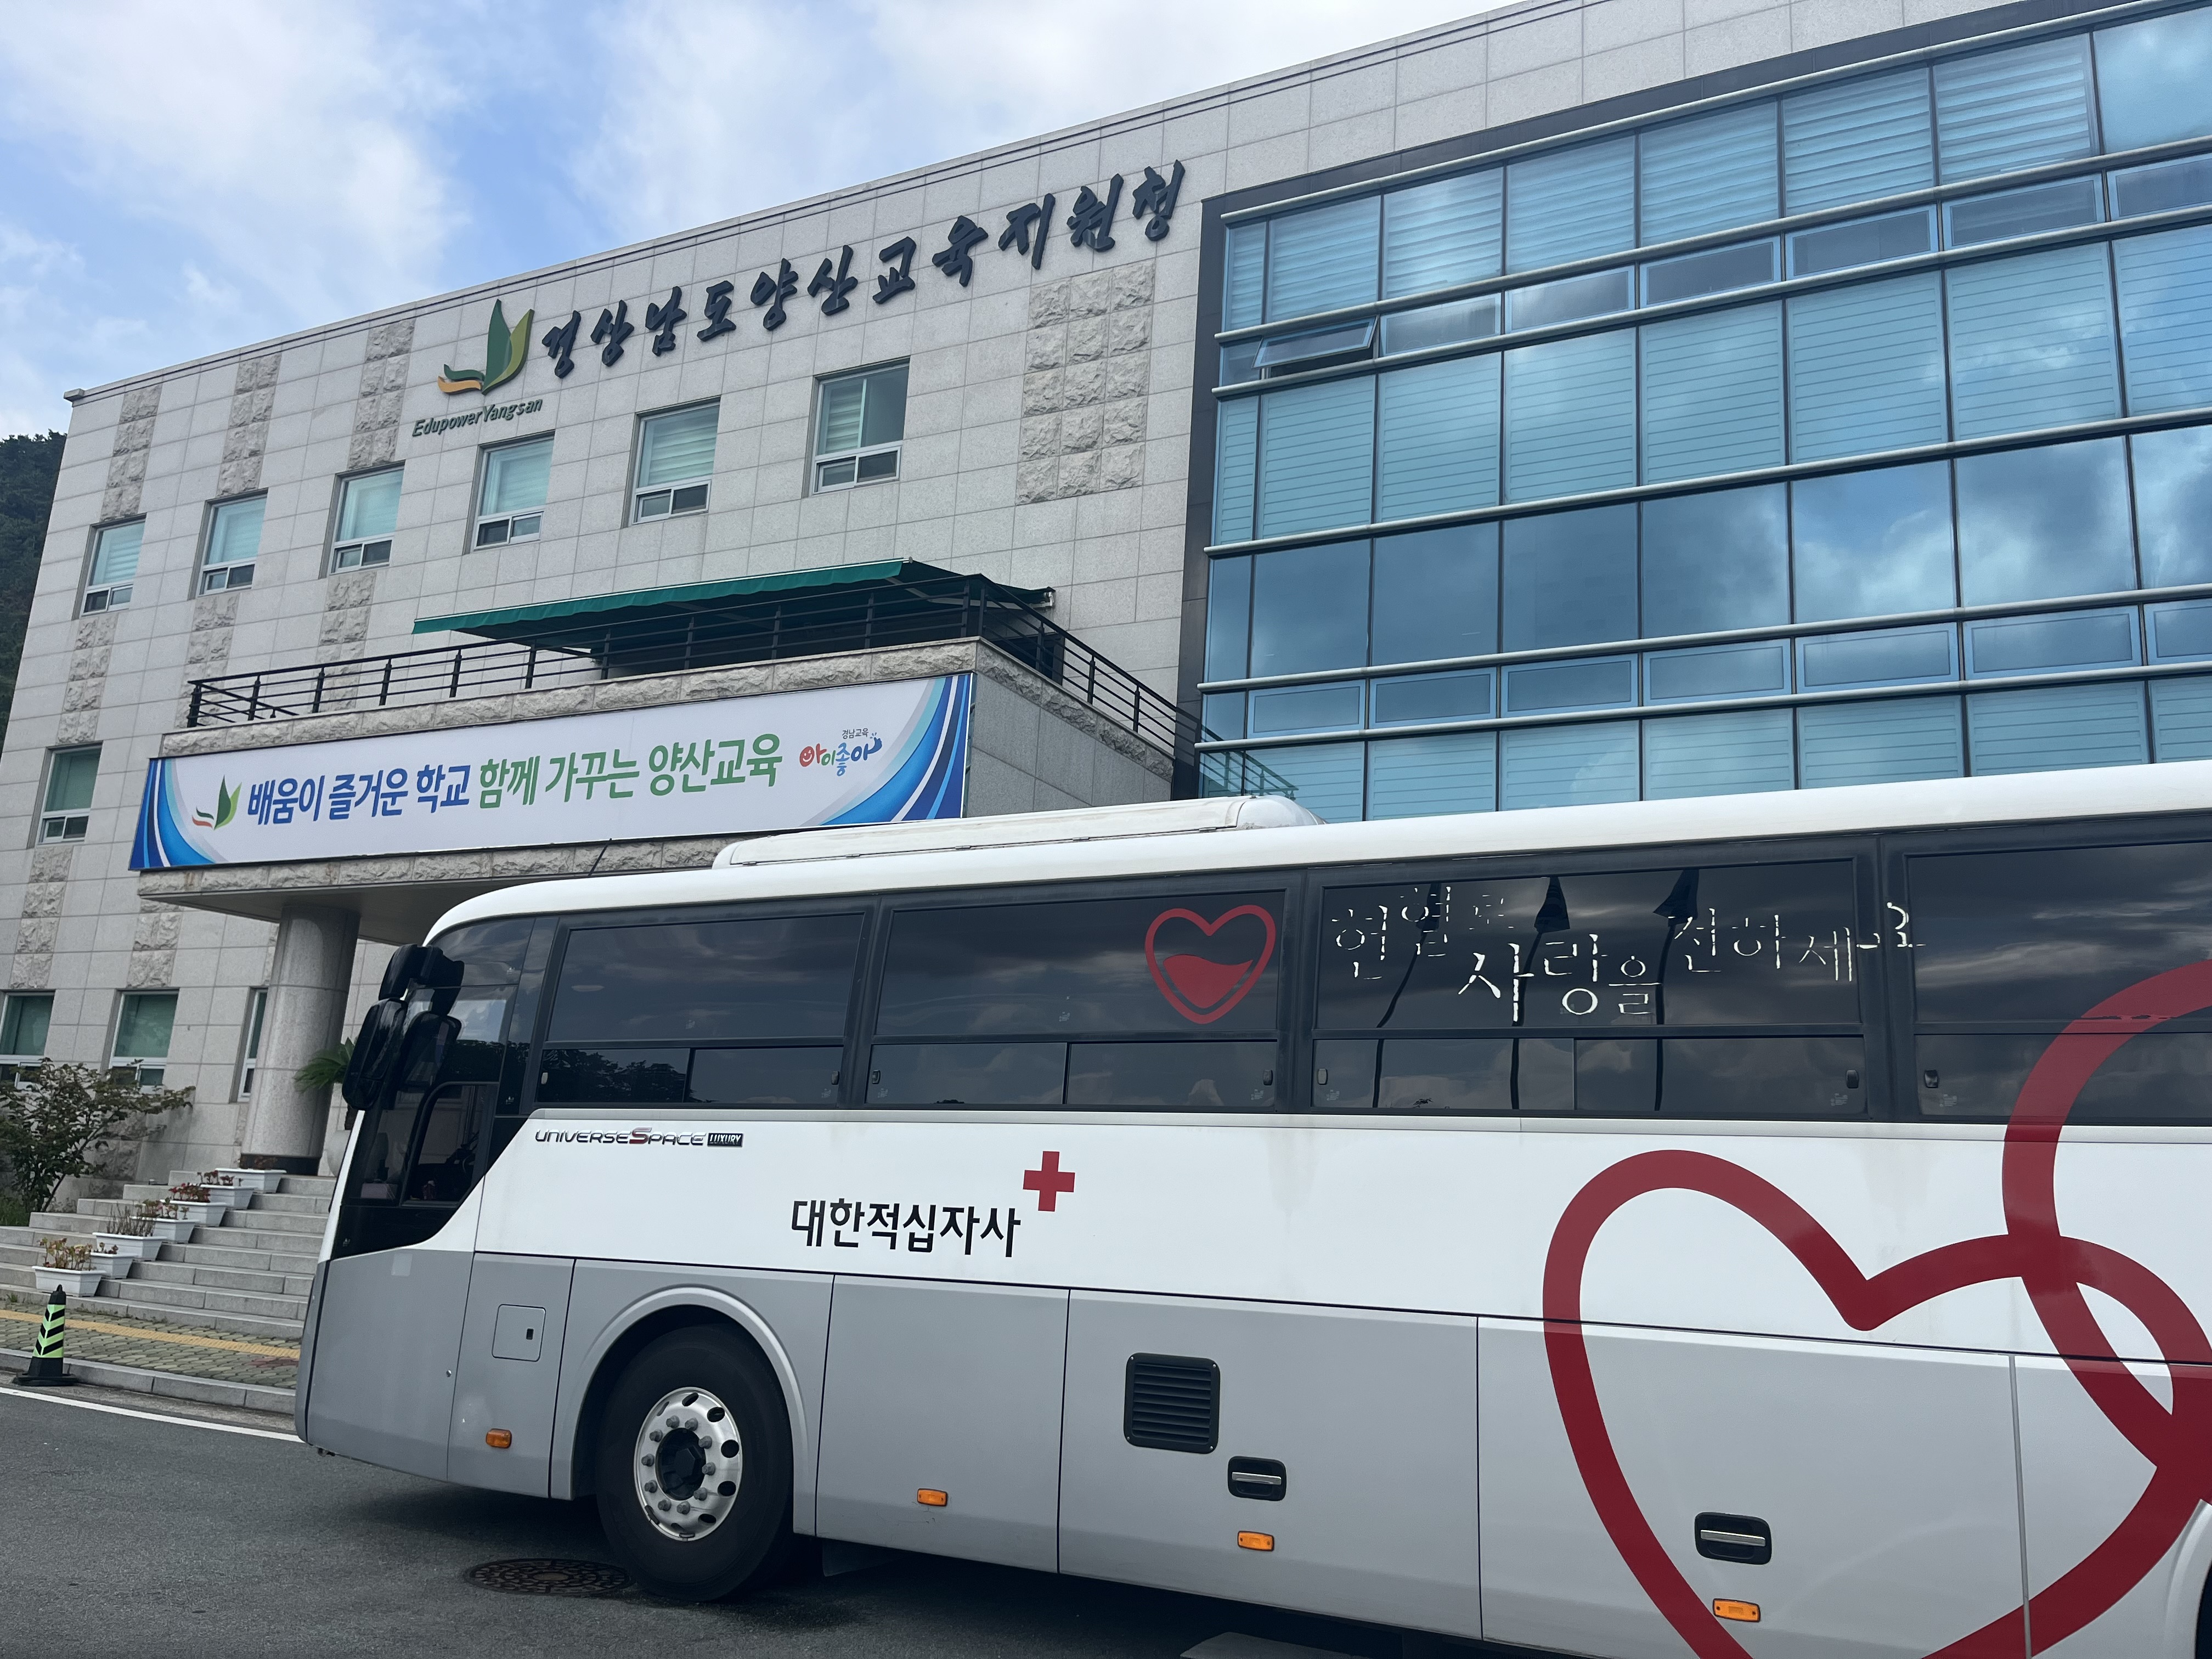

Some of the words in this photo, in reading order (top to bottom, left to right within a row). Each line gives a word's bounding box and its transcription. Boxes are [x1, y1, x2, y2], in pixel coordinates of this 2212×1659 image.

[799, 737, 882, 776] 아이좋아
[842, 728, 869, 740] 경남교육
[247, 775, 325, 825] 배움이
[329, 768, 408, 820] 즐거운
[416, 764, 471, 814] 학교
[480, 756, 540, 809] 함께
[545, 749, 639, 802] 가꾸는
[649, 733, 782, 796] 양산교육
[1458, 934, 1661, 1022] 사랑을
[708, 1133, 743, 1147] LUXURY
[792, 1198, 1021, 1257] 대한적십자사
